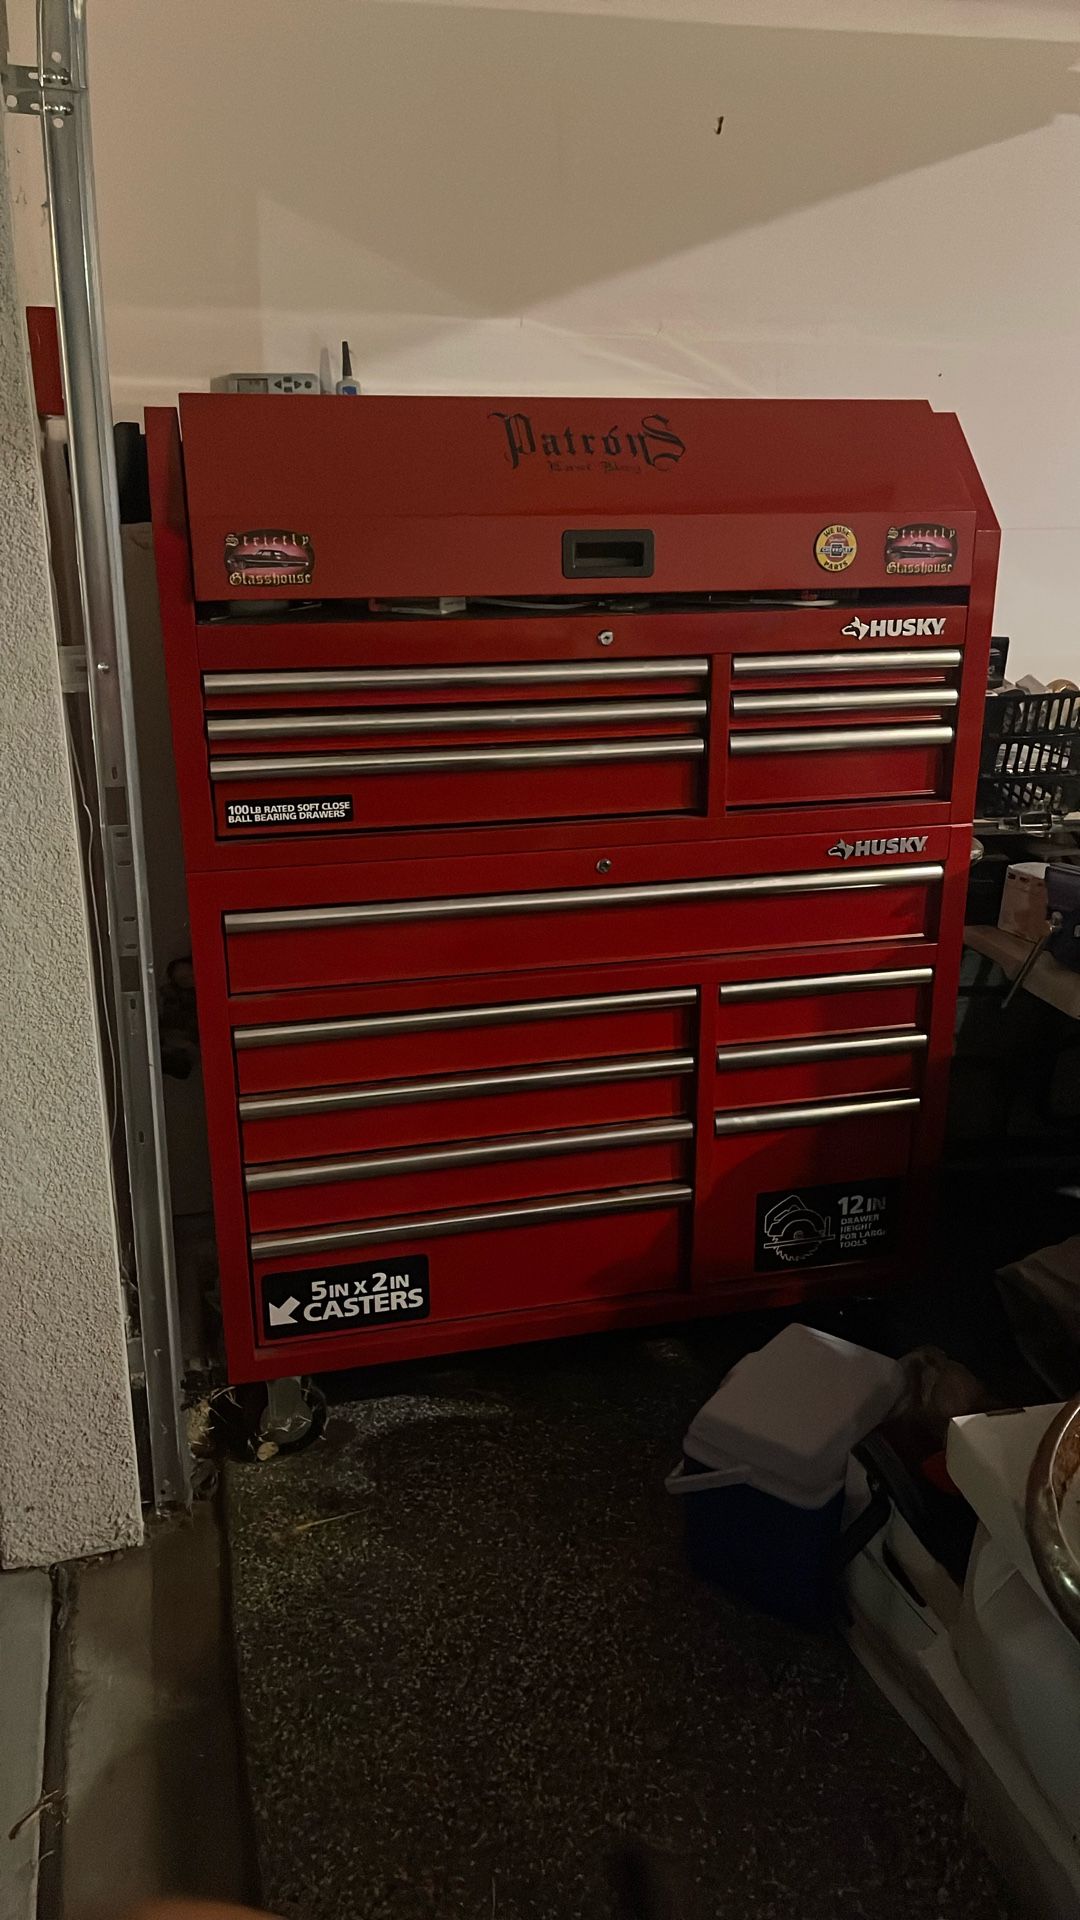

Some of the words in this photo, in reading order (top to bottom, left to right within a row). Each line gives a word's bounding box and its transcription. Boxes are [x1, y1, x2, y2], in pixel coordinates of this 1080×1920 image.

[823, 527, 834, 537] WE
[836, 526, 850, 537] USE
[887, 526, 956, 540] Strictly
[225, 533, 310, 547] Strictly
[824, 560, 848, 570] PARTS
[886, 561, 953, 575] Glasshouse
[229, 571, 311, 586] Glasshouse
[869, 617, 947, 638] HUSKY
[264, 804, 295, 814] RATED
[297, 803, 320, 812] SOFT
[321, 801, 350, 811] CLOSE
[228, 814, 253, 824] BALL
[254, 812, 297, 822] BEARING
[299, 809, 345, 820] DRAWERS
[854, 835, 929, 857] HUSKY
[841, 1214, 879, 1225] DRAWER
[840, 1223, 872, 1234] HEIGHT
[840, 1232, 857, 1241] FOR
[840, 1239, 867, 1249] TOOLS
[303, 1288, 424, 1322] CASTERS
